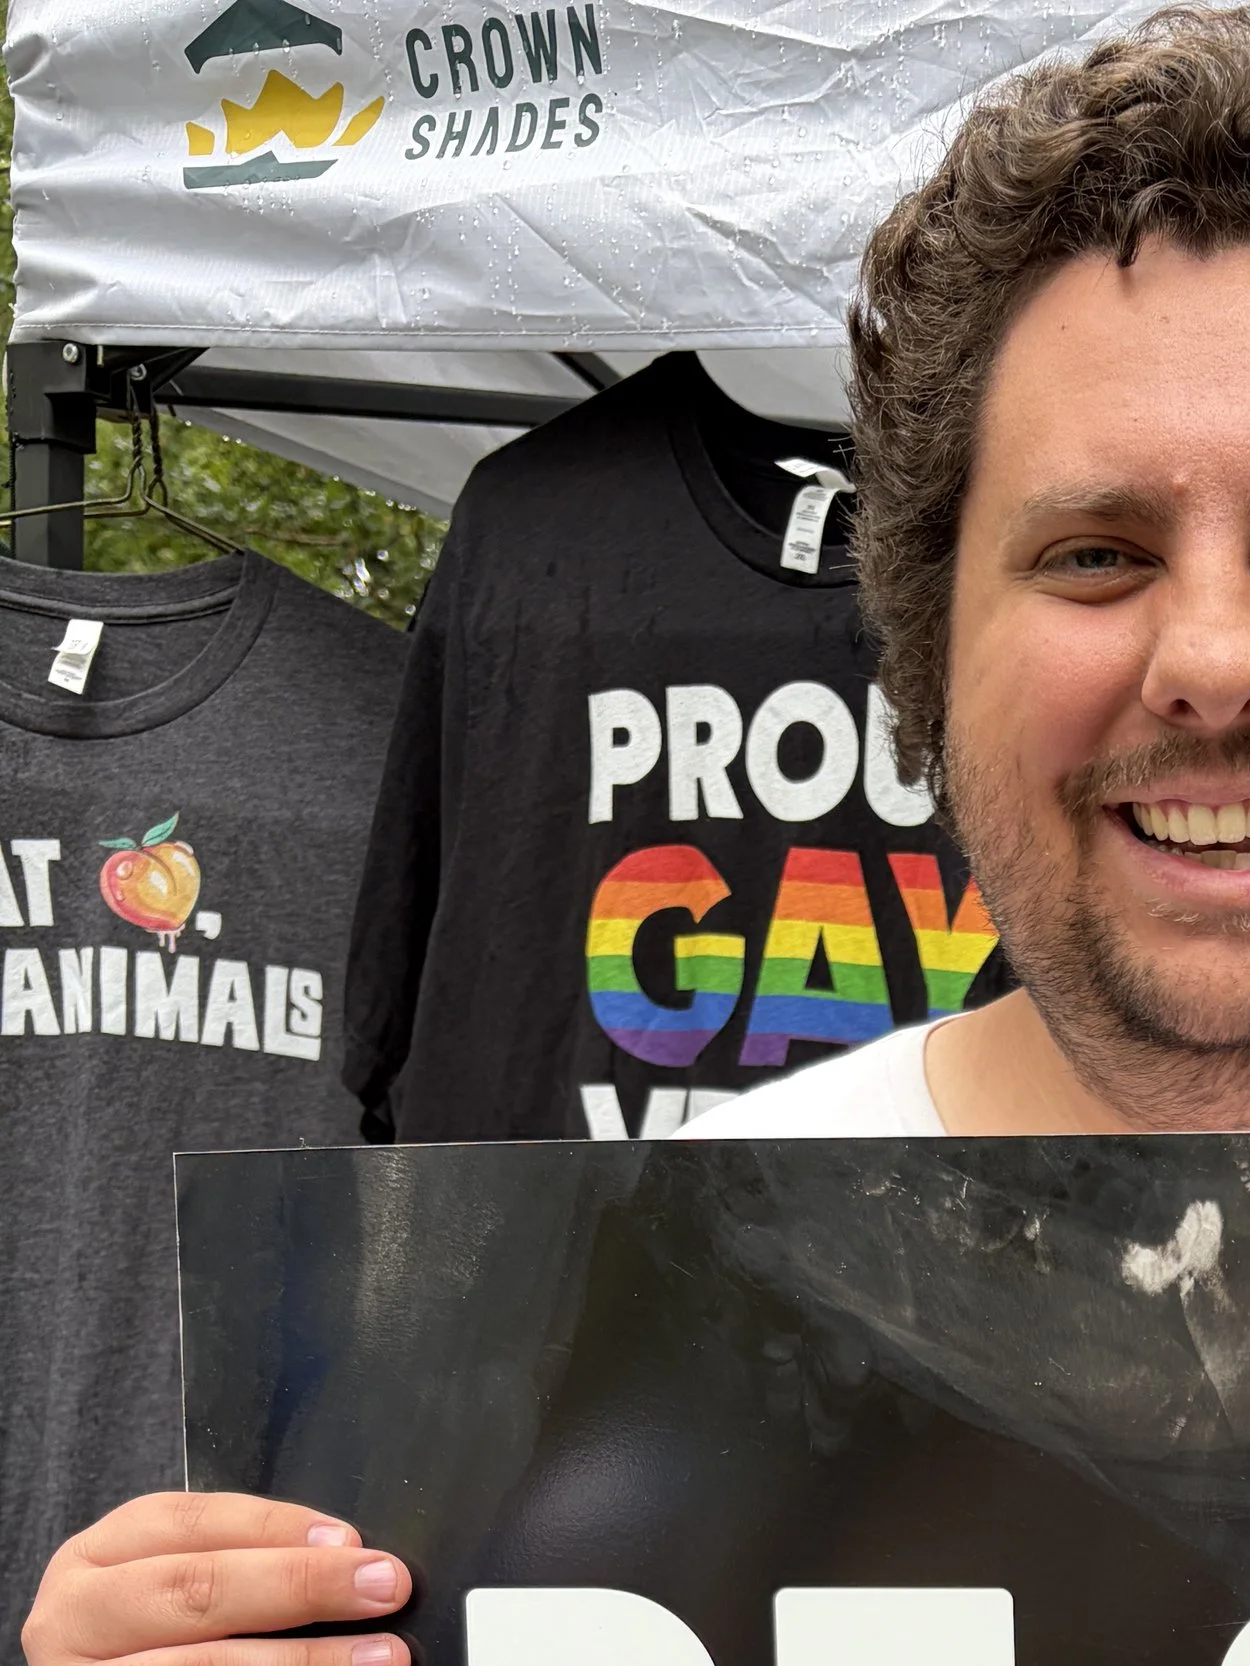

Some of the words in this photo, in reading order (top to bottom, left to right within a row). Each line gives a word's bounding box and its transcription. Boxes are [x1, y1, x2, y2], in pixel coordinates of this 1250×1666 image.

[405, 3, 603, 99] CROWN
[405, 92, 603, 160] SHADES
[0, 945, 323, 1062] ANIMALS
[585, 844, 1000, 1067] GAY
